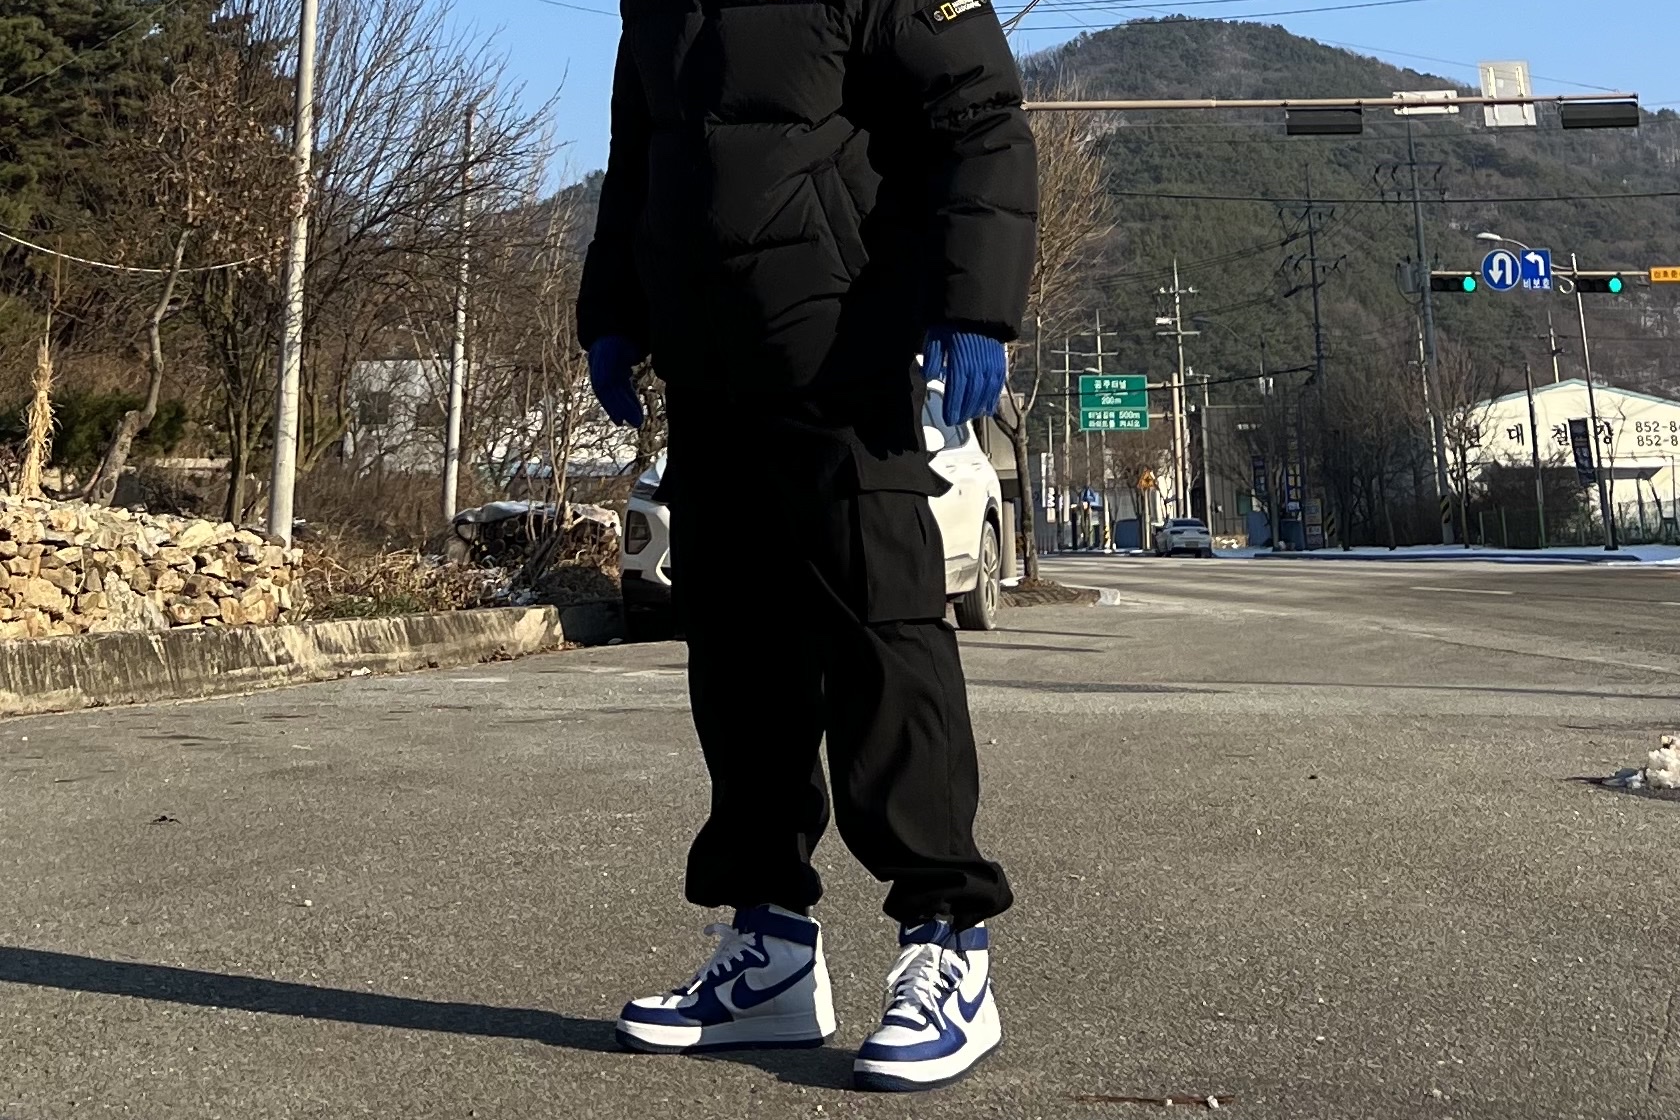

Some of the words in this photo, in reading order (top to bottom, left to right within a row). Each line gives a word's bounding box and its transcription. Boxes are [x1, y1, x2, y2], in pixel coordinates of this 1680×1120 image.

[1523, 277, 1550, 289] 비보호
[1101, 396, 1122, 405] 200m
[1635, 420, 1680, 433] 852-8
